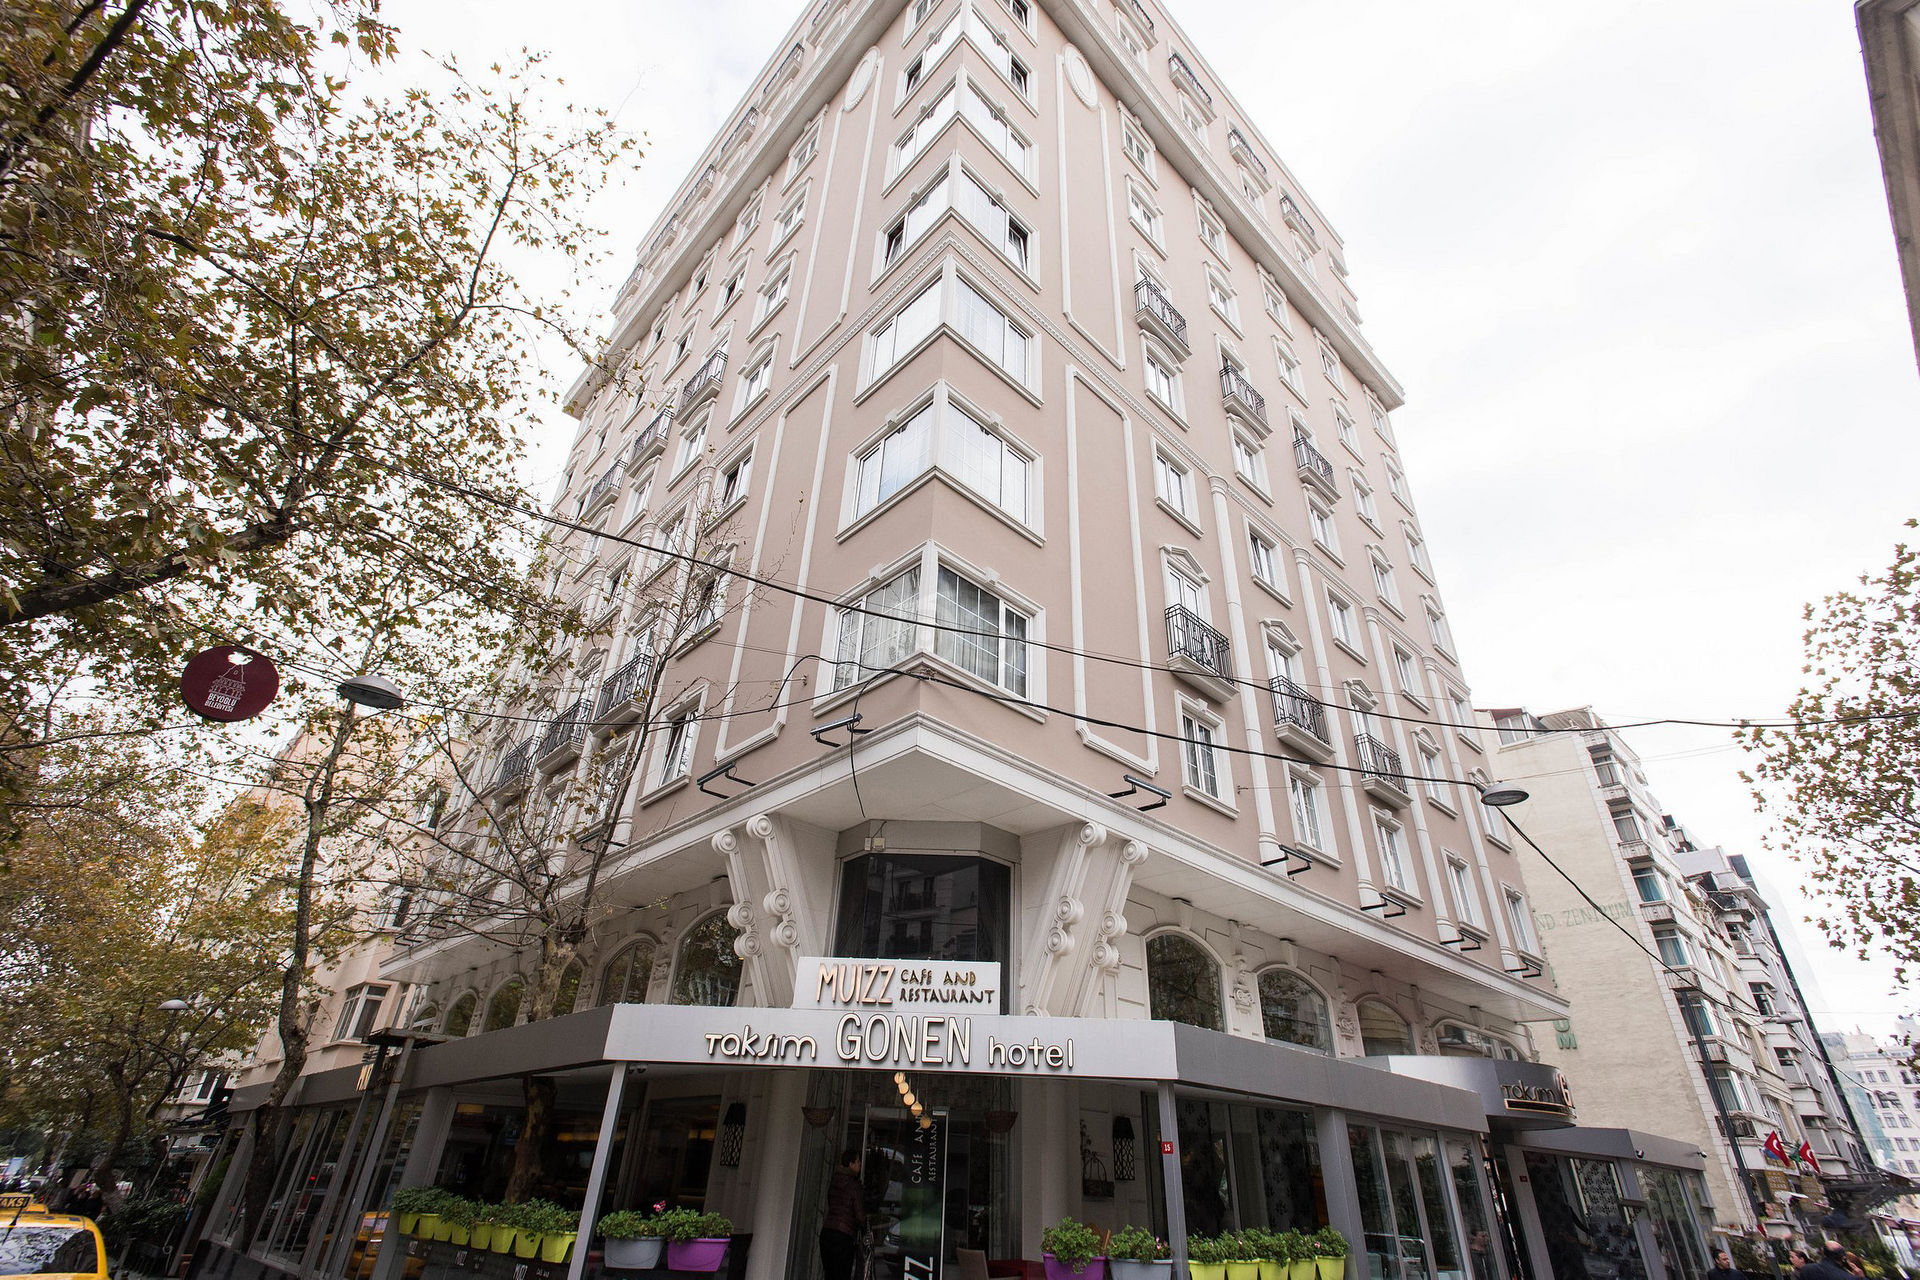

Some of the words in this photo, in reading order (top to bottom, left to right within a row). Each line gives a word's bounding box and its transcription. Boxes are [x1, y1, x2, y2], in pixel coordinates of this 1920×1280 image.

[816, 962, 896, 1004] MUIZZ
[900, 968, 932, 986] CAFE
[943, 970, 977, 987] AND
[899, 988, 995, 1004] RESTAURANT
[836, 1012, 972, 1065] GONEN
[988, 1035, 1075, 1069] hotel
[928, 1118, 938, 1182] RESTAURANT
[1164, 1143, 1171, 1152] 15
[911, 1153, 923, 1184] CAFE
